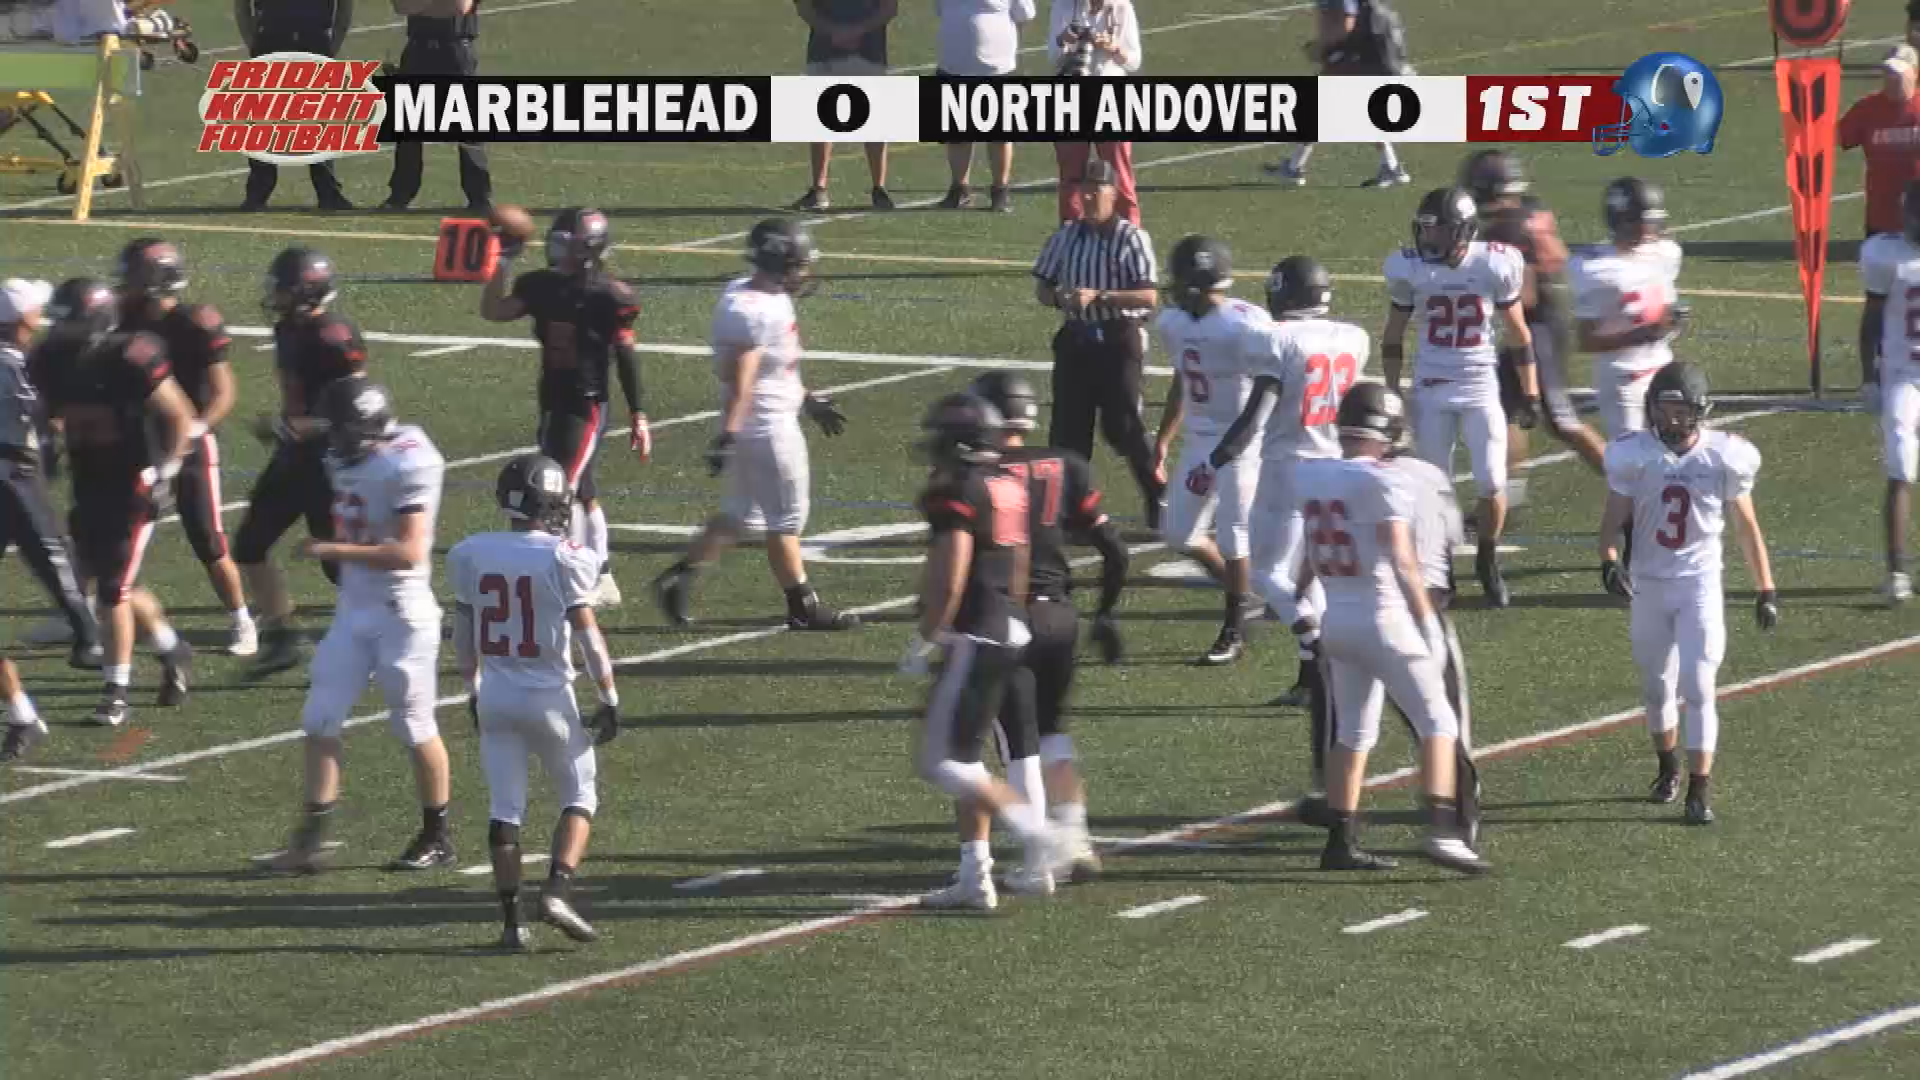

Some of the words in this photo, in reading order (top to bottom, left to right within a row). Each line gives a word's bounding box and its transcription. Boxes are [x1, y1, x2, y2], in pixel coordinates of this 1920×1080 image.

[444, 224, 488, 273] 10
[1426, 294, 1485, 347] 22
[1184, 349, 1209, 403] 6
[1656, 484, 1690, 549] 3
[479, 573, 541, 658] 21
